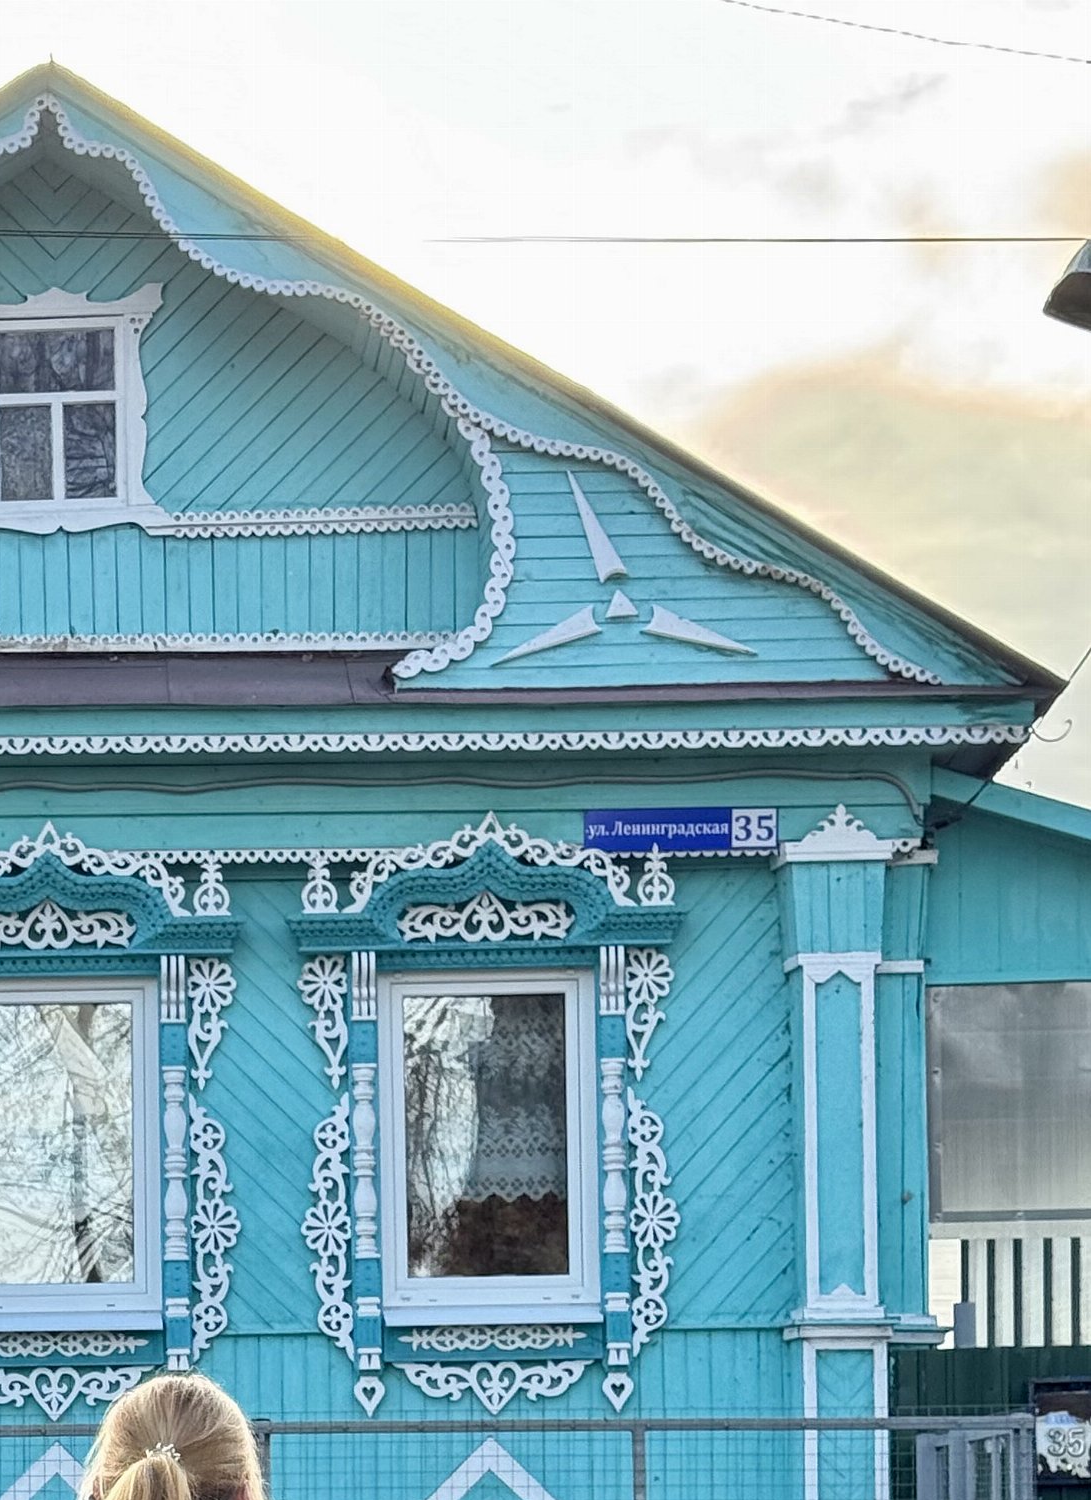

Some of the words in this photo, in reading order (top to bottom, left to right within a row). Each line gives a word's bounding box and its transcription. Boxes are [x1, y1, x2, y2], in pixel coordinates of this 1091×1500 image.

[587, 822, 609, 839] ул.
[611, 820, 729, 839] Ленинградская
[734, 814, 774, 842] 35
[1047, 1427, 1086, 1458] 35
